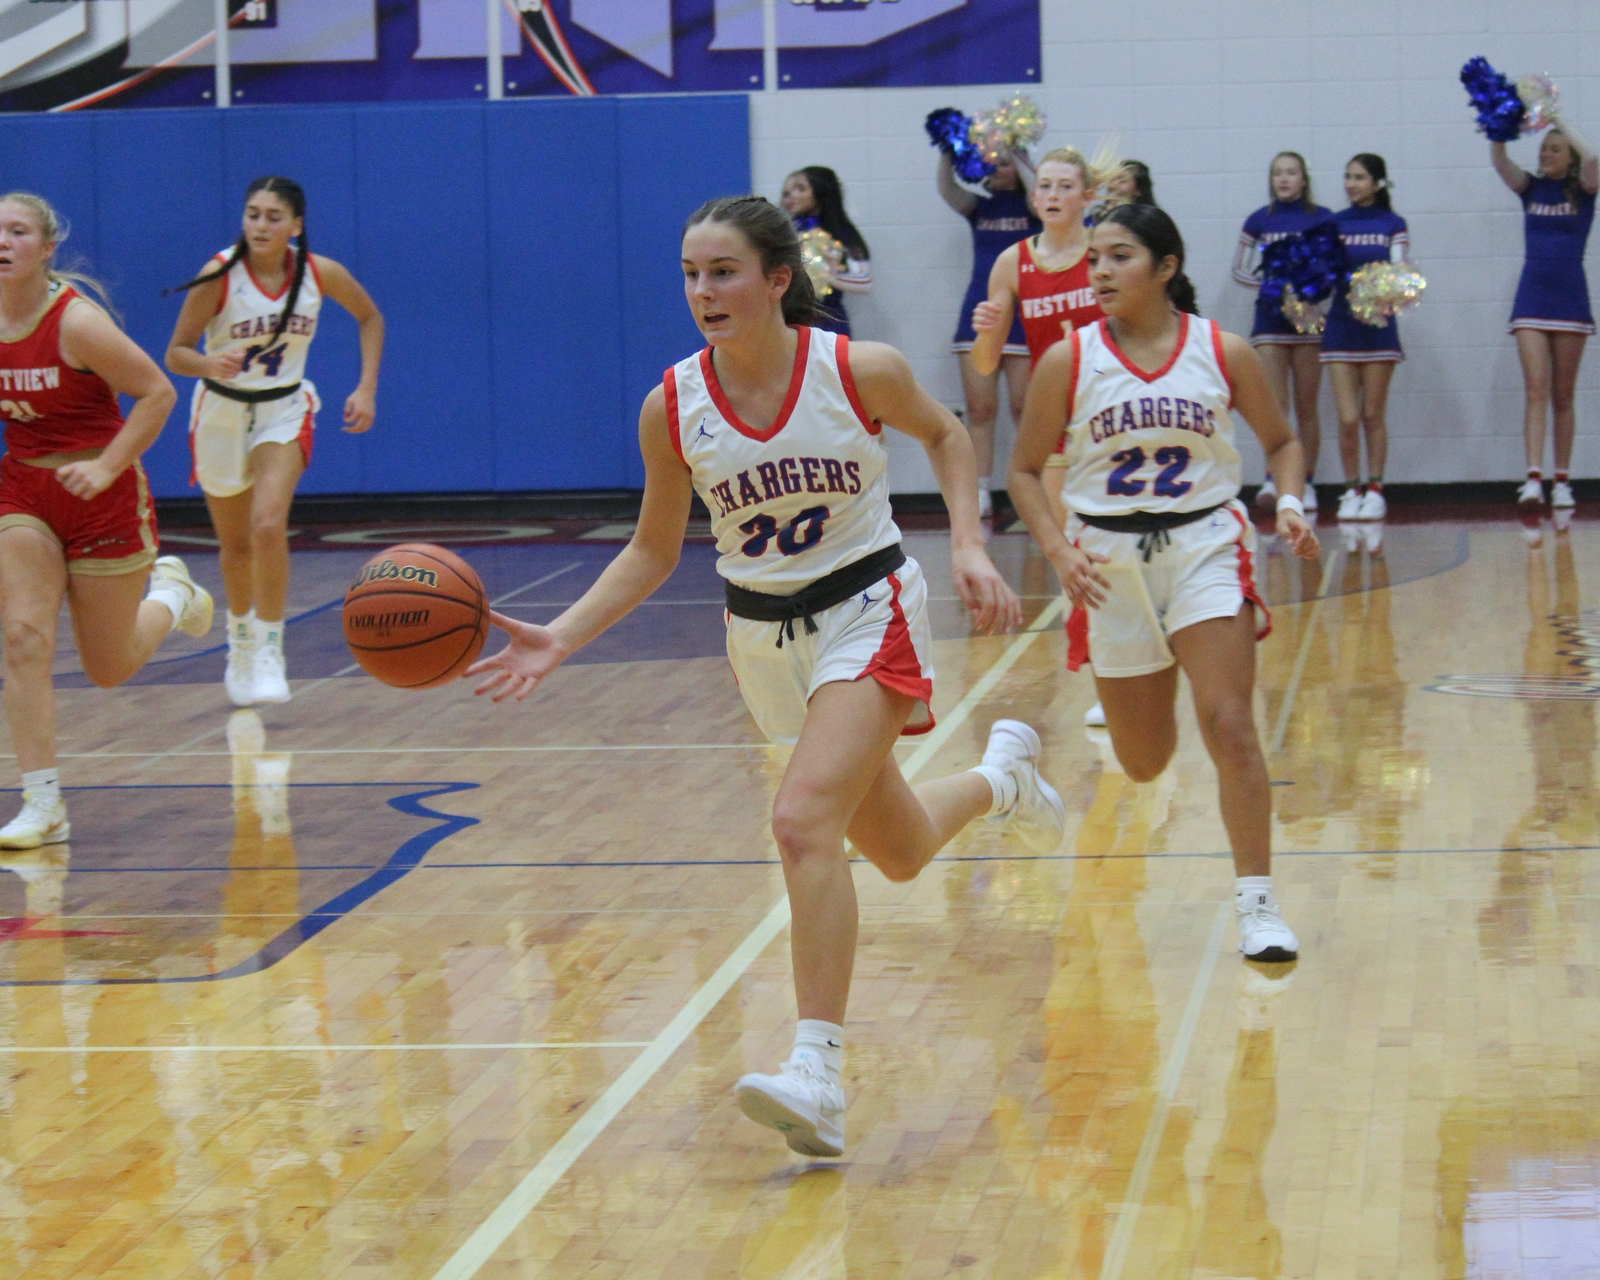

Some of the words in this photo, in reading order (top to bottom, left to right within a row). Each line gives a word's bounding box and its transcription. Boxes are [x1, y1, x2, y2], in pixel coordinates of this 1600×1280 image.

[1021, 287, 1097, 319] WESTVIE
[0, 366, 60, 392] TVIEW
[1089, 396, 1216, 444] CHARGERS
[709, 456, 862, 518] CHARGERS
[1106, 445, 1194, 498] 22
[349, 610, 431, 628] EVOLUTION
